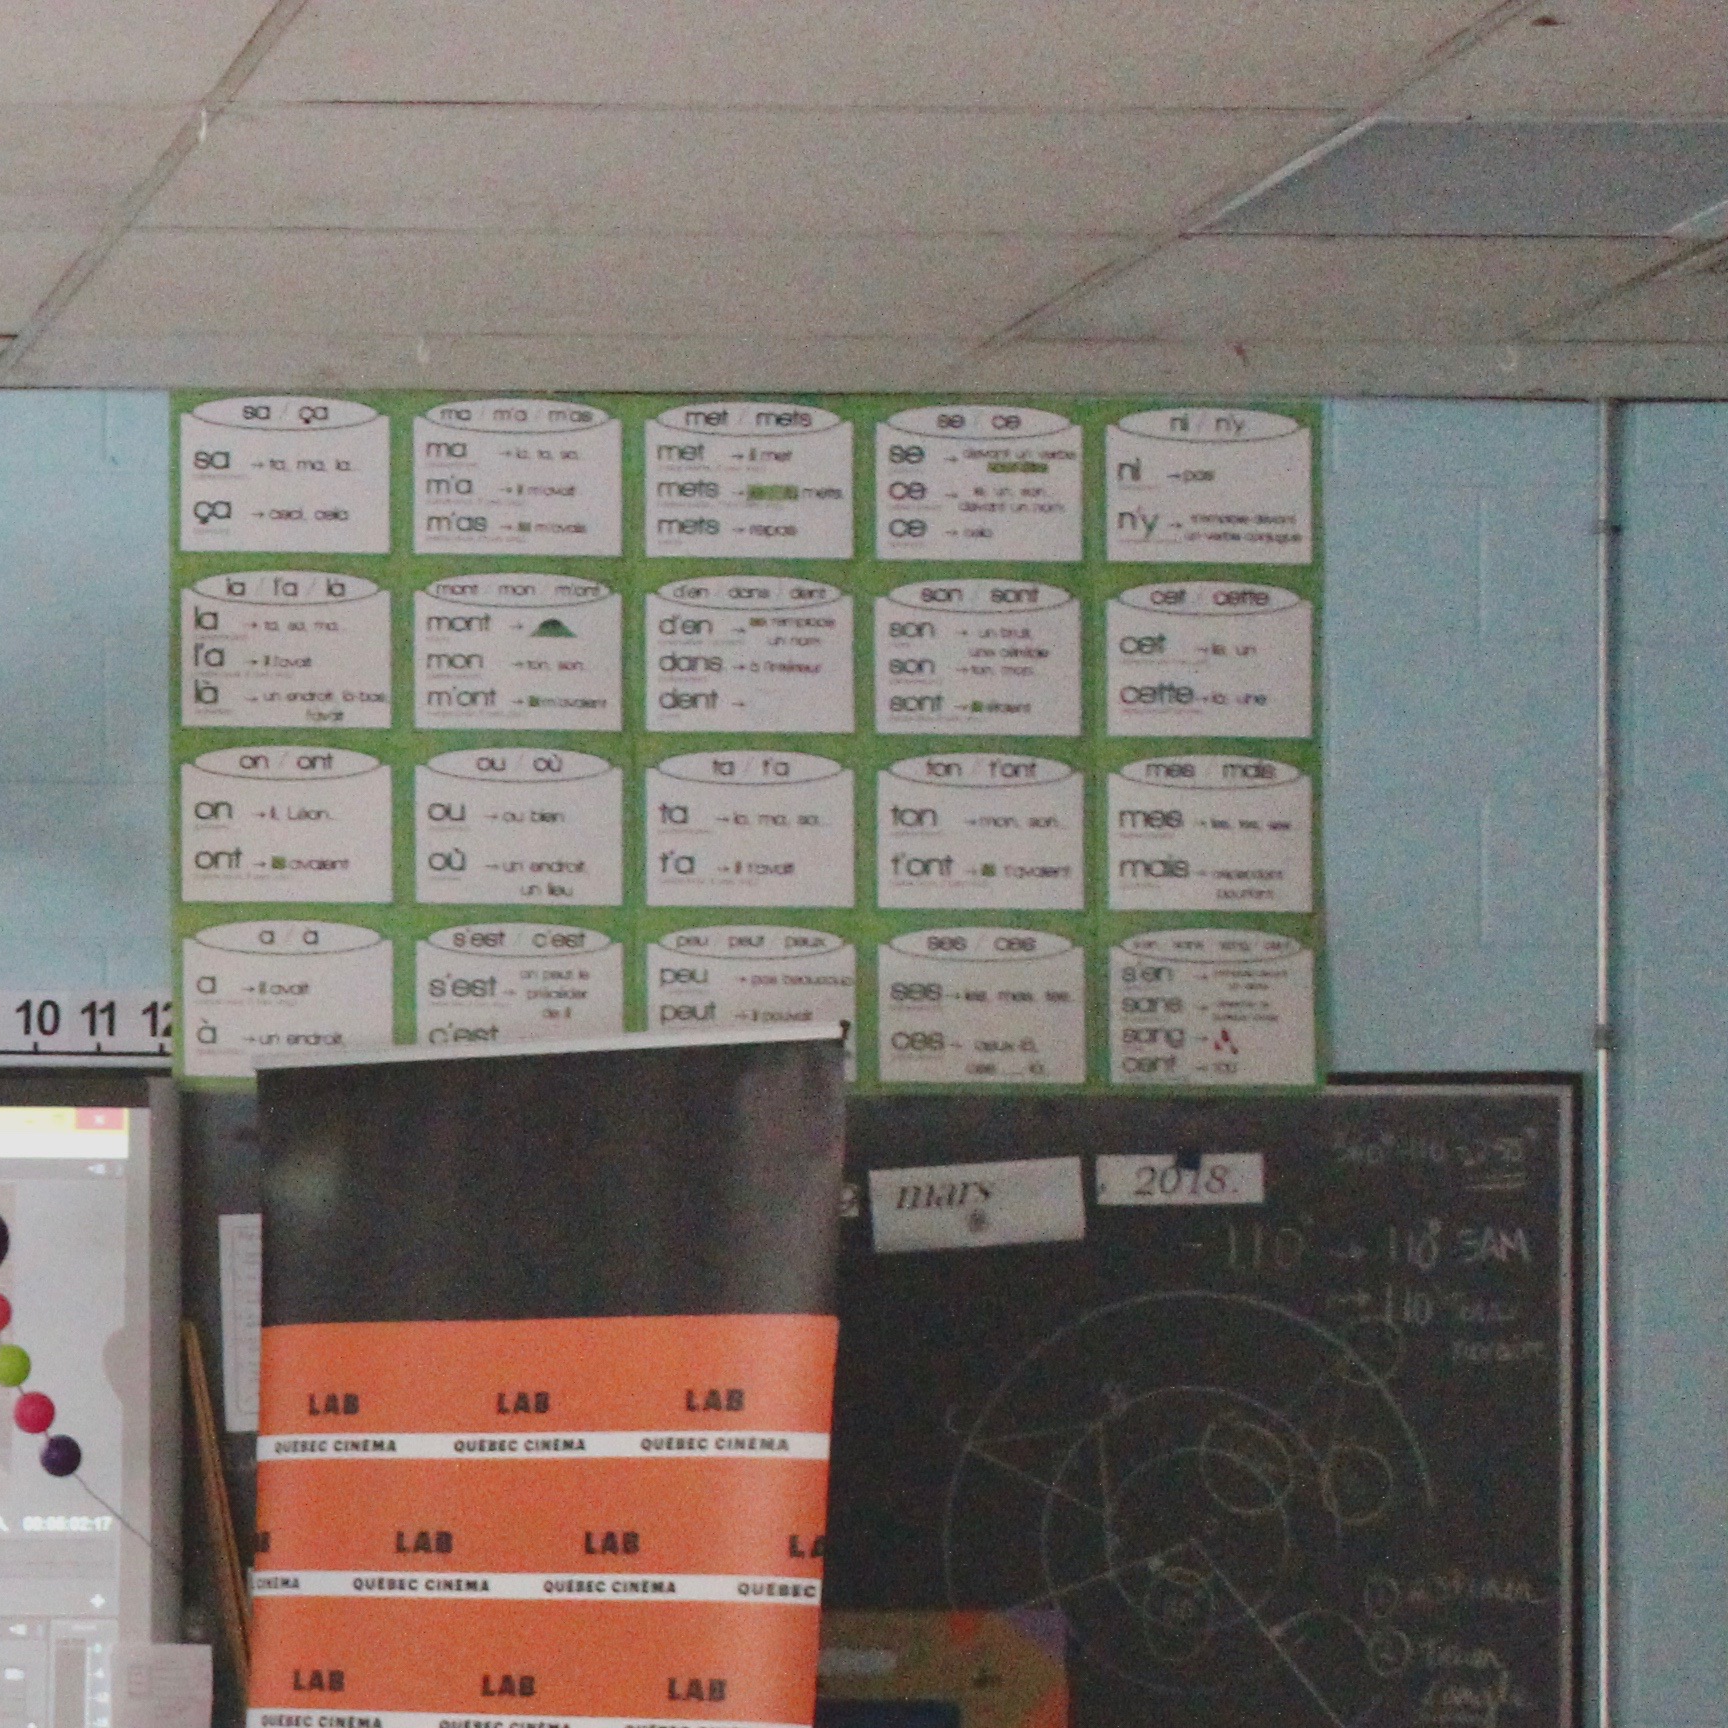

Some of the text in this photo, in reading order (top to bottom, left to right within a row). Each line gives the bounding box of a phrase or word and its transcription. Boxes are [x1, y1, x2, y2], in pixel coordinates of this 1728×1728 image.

[243, 405, 329, 426] sa ça
[440, 408, 472, 422] ma
[685, 409, 812, 428] met mets
[1170, 413, 1190, 432] ni
[194, 450, 231, 470] sa
[425, 441, 468, 459] ma
[656, 443, 705, 462] met
[889, 445, 925, 465] se
[1117, 457, 1142, 482] ni
[426, 475, 474, 496] m'a
[657, 479, 720, 499] mets
[888, 480, 928, 501] ce
[192, 500, 233, 526] ça
[1117, 506, 1160, 539] n'y
[426, 515, 488, 533] m'as
[657, 516, 720, 536] mets
[888, 518, 928, 539] ce
[193, 606, 219, 631] la
[426, 613, 492, 633] mont
[658, 615, 714, 636] d'en
[889, 621, 936, 639] son
[1119, 633, 1167, 655] cet
[193, 642, 226, 668] l'a
[426, 653, 484, 670] mon
[659, 652, 723, 673] dans
[889, 658, 935, 675] son
[426, 686, 497, 708] m'ont
[658, 688, 719, 710] dent
[889, 694, 944, 713] sont
[1120, 682, 1196, 706] cette
[239, 753, 334, 771] on ont
[476, 757, 506, 772] ou
[193, 800, 233, 821] on
[427, 802, 467, 823] ou
[658, 803, 689, 825] ta
[890, 804, 938, 828] ton
[1118, 809, 1184, 830] mes
[194, 847, 243, 871] ont
[427, 847, 467, 872] où
[659, 850, 696, 876] t'a
[890, 854, 954, 878] t'ont
[1119, 858, 1190, 879] mais
[195, 975, 217, 996] a
[428, 973, 498, 999] s'est
[659, 967, 708, 987] peu
[16, 999, 60, 1036] 10
[81, 1000, 115, 1036] 11
[659, 1001, 717, 1025] peut
[196, 1018, 218, 1046] à
[896, 1181, 995, 1209] mars
[308, 1388, 744, 1417] LAB LAB LAB
[395, 1530, 825, 1558] LAB LAB LA
[293, 1669, 726, 1702] LAB LAB LAB
